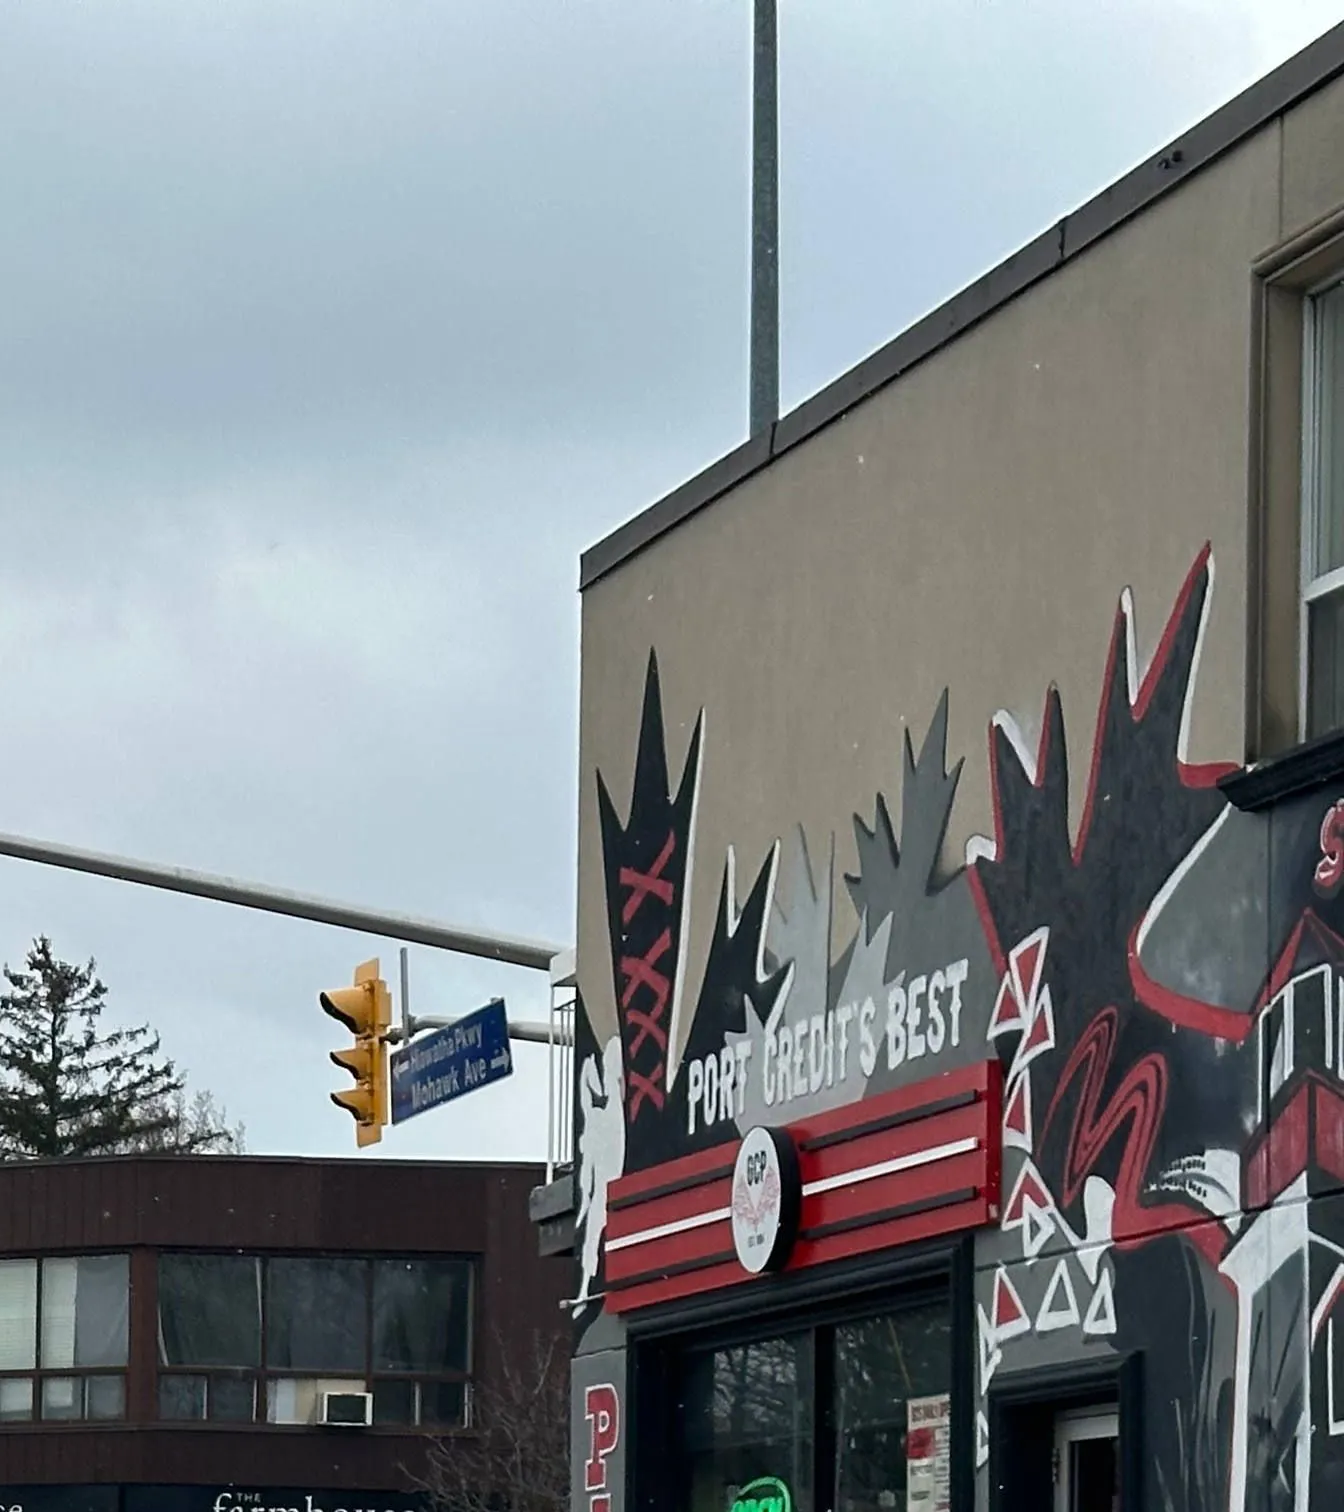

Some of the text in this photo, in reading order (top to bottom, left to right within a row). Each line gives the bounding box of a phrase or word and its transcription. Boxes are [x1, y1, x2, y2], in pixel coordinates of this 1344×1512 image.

[454, 1022, 483, 1053] Pkwy
[687, 958, 969, 1135] PORT CREDIT'S BEST
[412, 1057, 487, 1110] Mohawk Ave
[236, 1492, 262, 1503] THE
